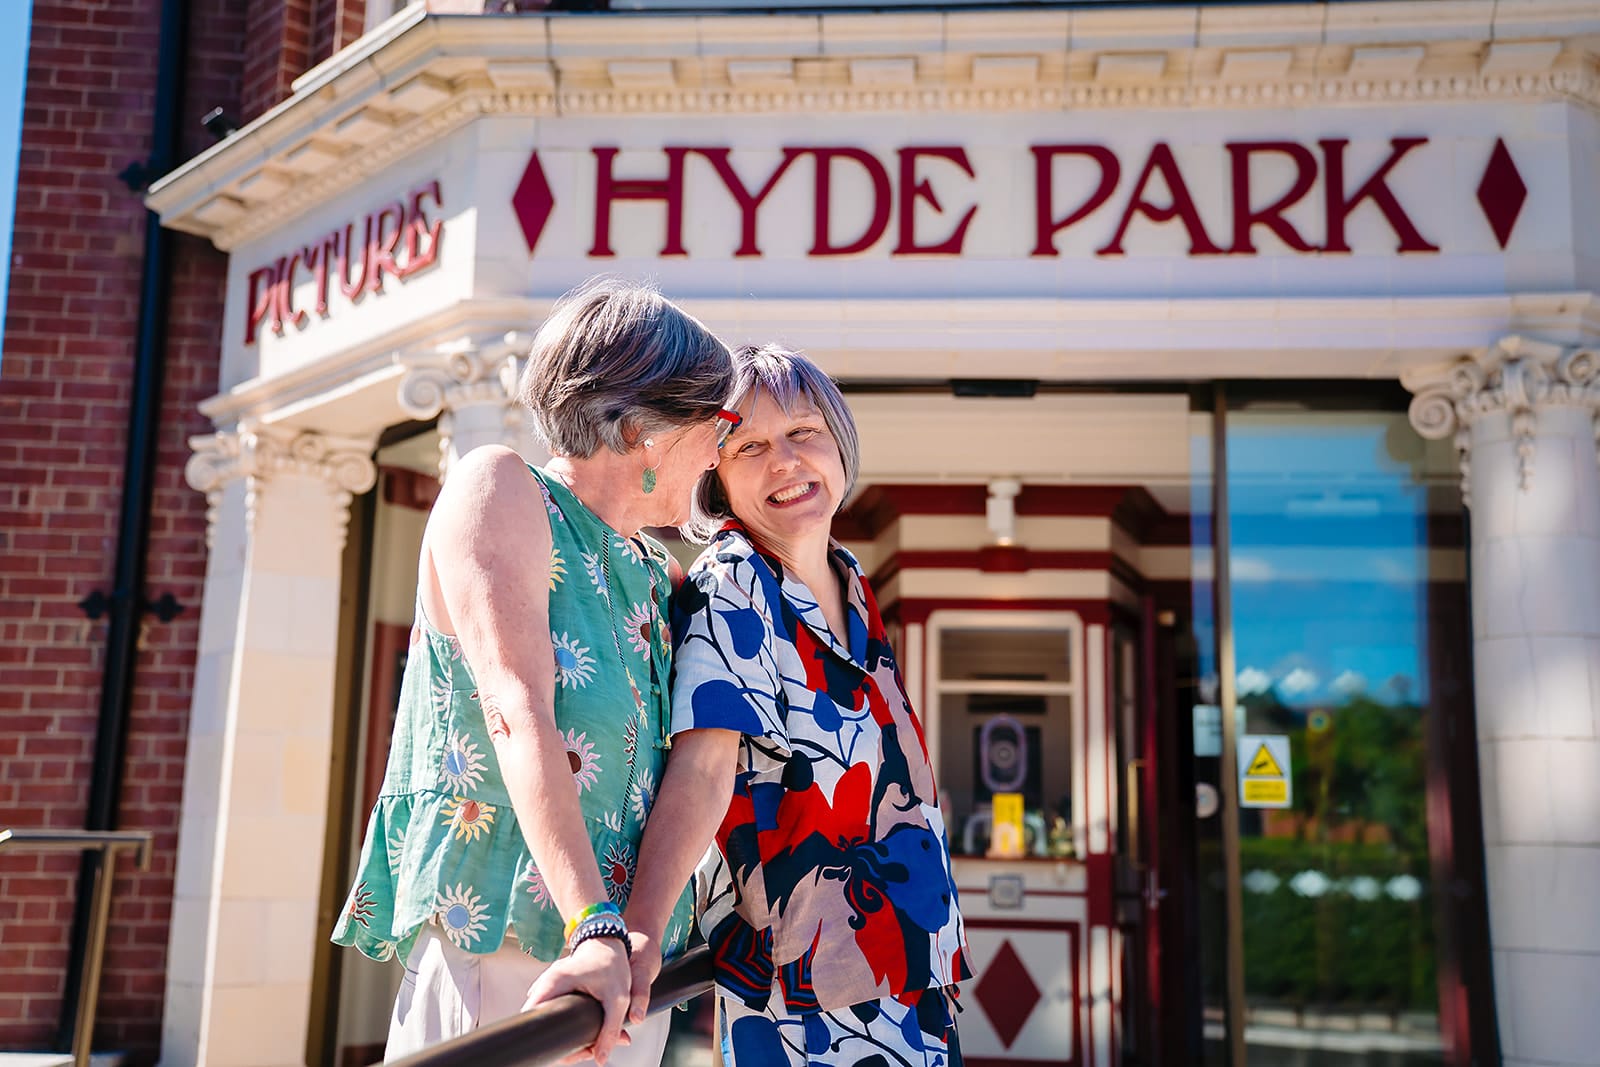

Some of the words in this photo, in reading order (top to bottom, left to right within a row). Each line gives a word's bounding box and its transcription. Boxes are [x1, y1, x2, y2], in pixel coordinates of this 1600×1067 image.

[244, 180, 444, 346] PICTURE
[586, 146, 980, 257] HYDE
[1029, 137, 1440, 257] PARK
